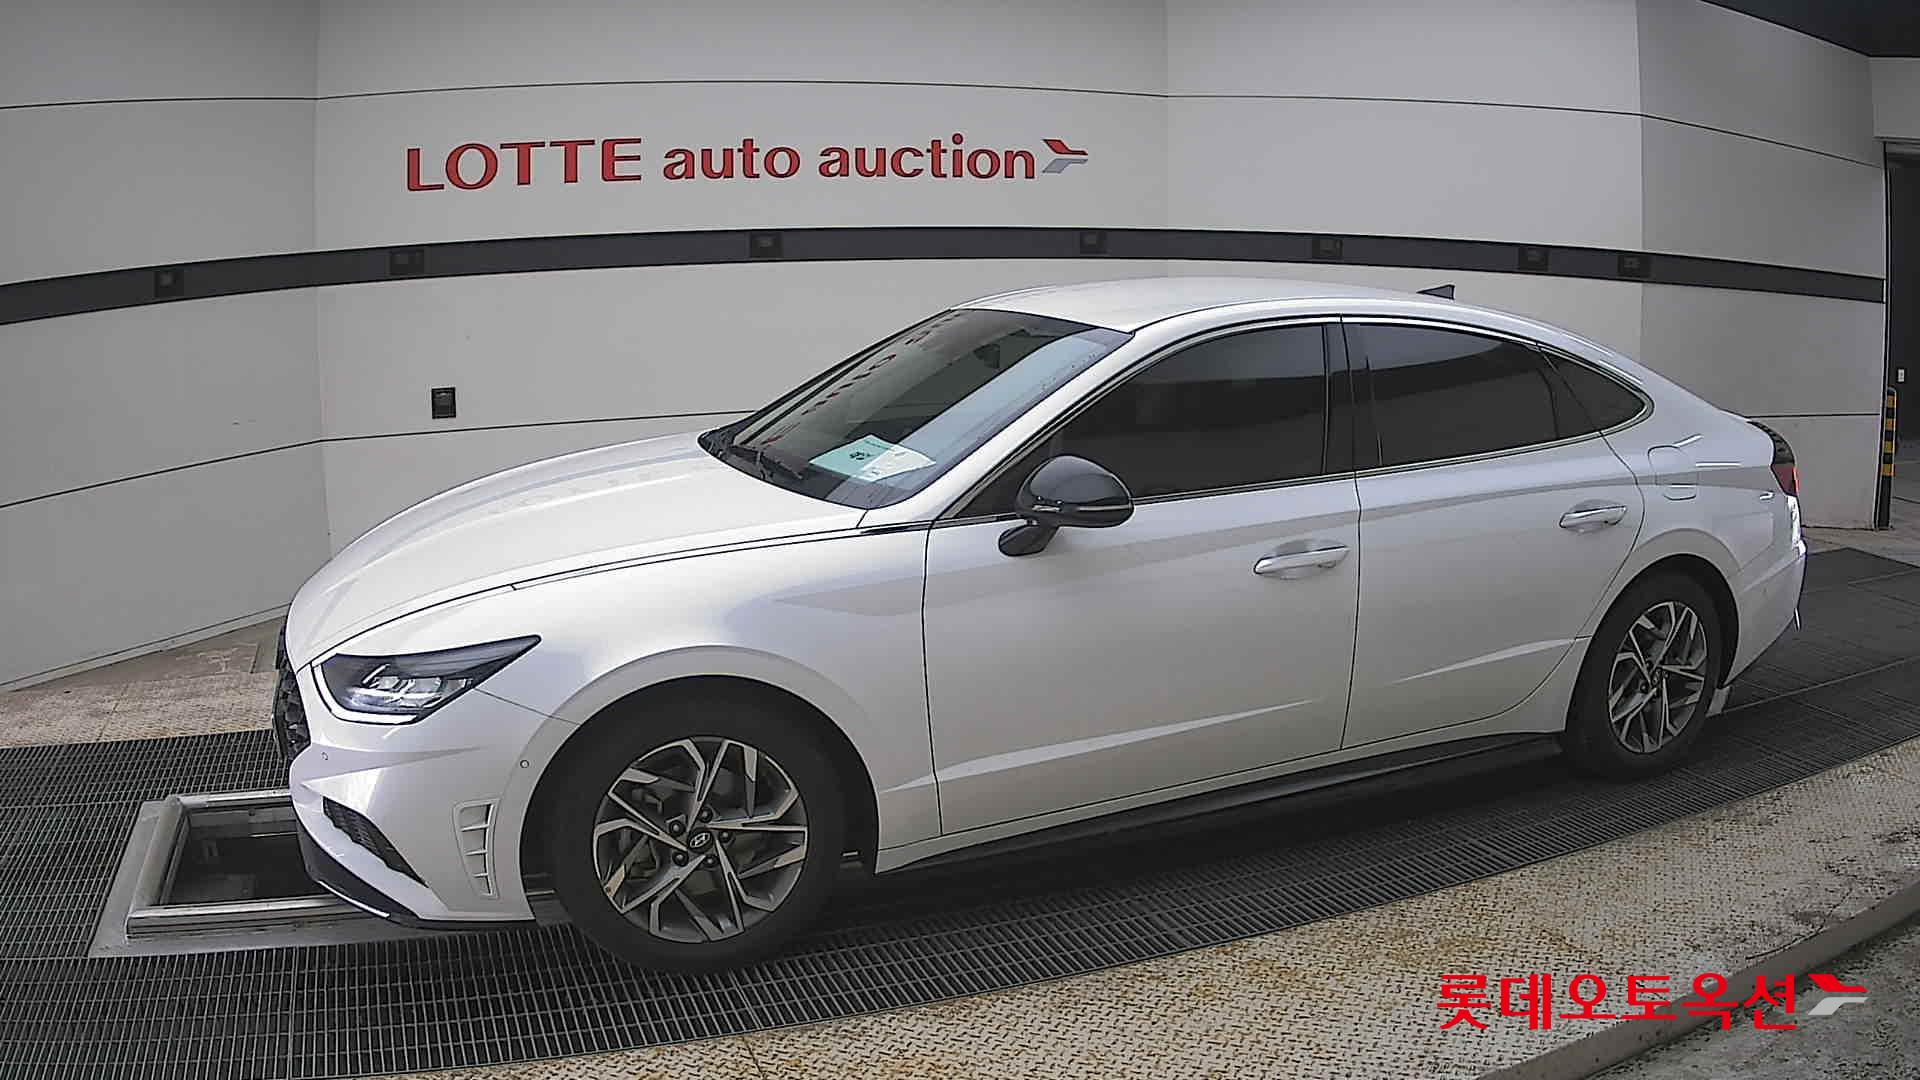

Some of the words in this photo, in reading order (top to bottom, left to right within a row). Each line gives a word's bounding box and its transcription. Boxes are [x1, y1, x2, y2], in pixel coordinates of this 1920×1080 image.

[406, 137, 642, 191] LOTTE
[662, 138, 802, 180] auto
[817, 132, 1036, 179] auction
